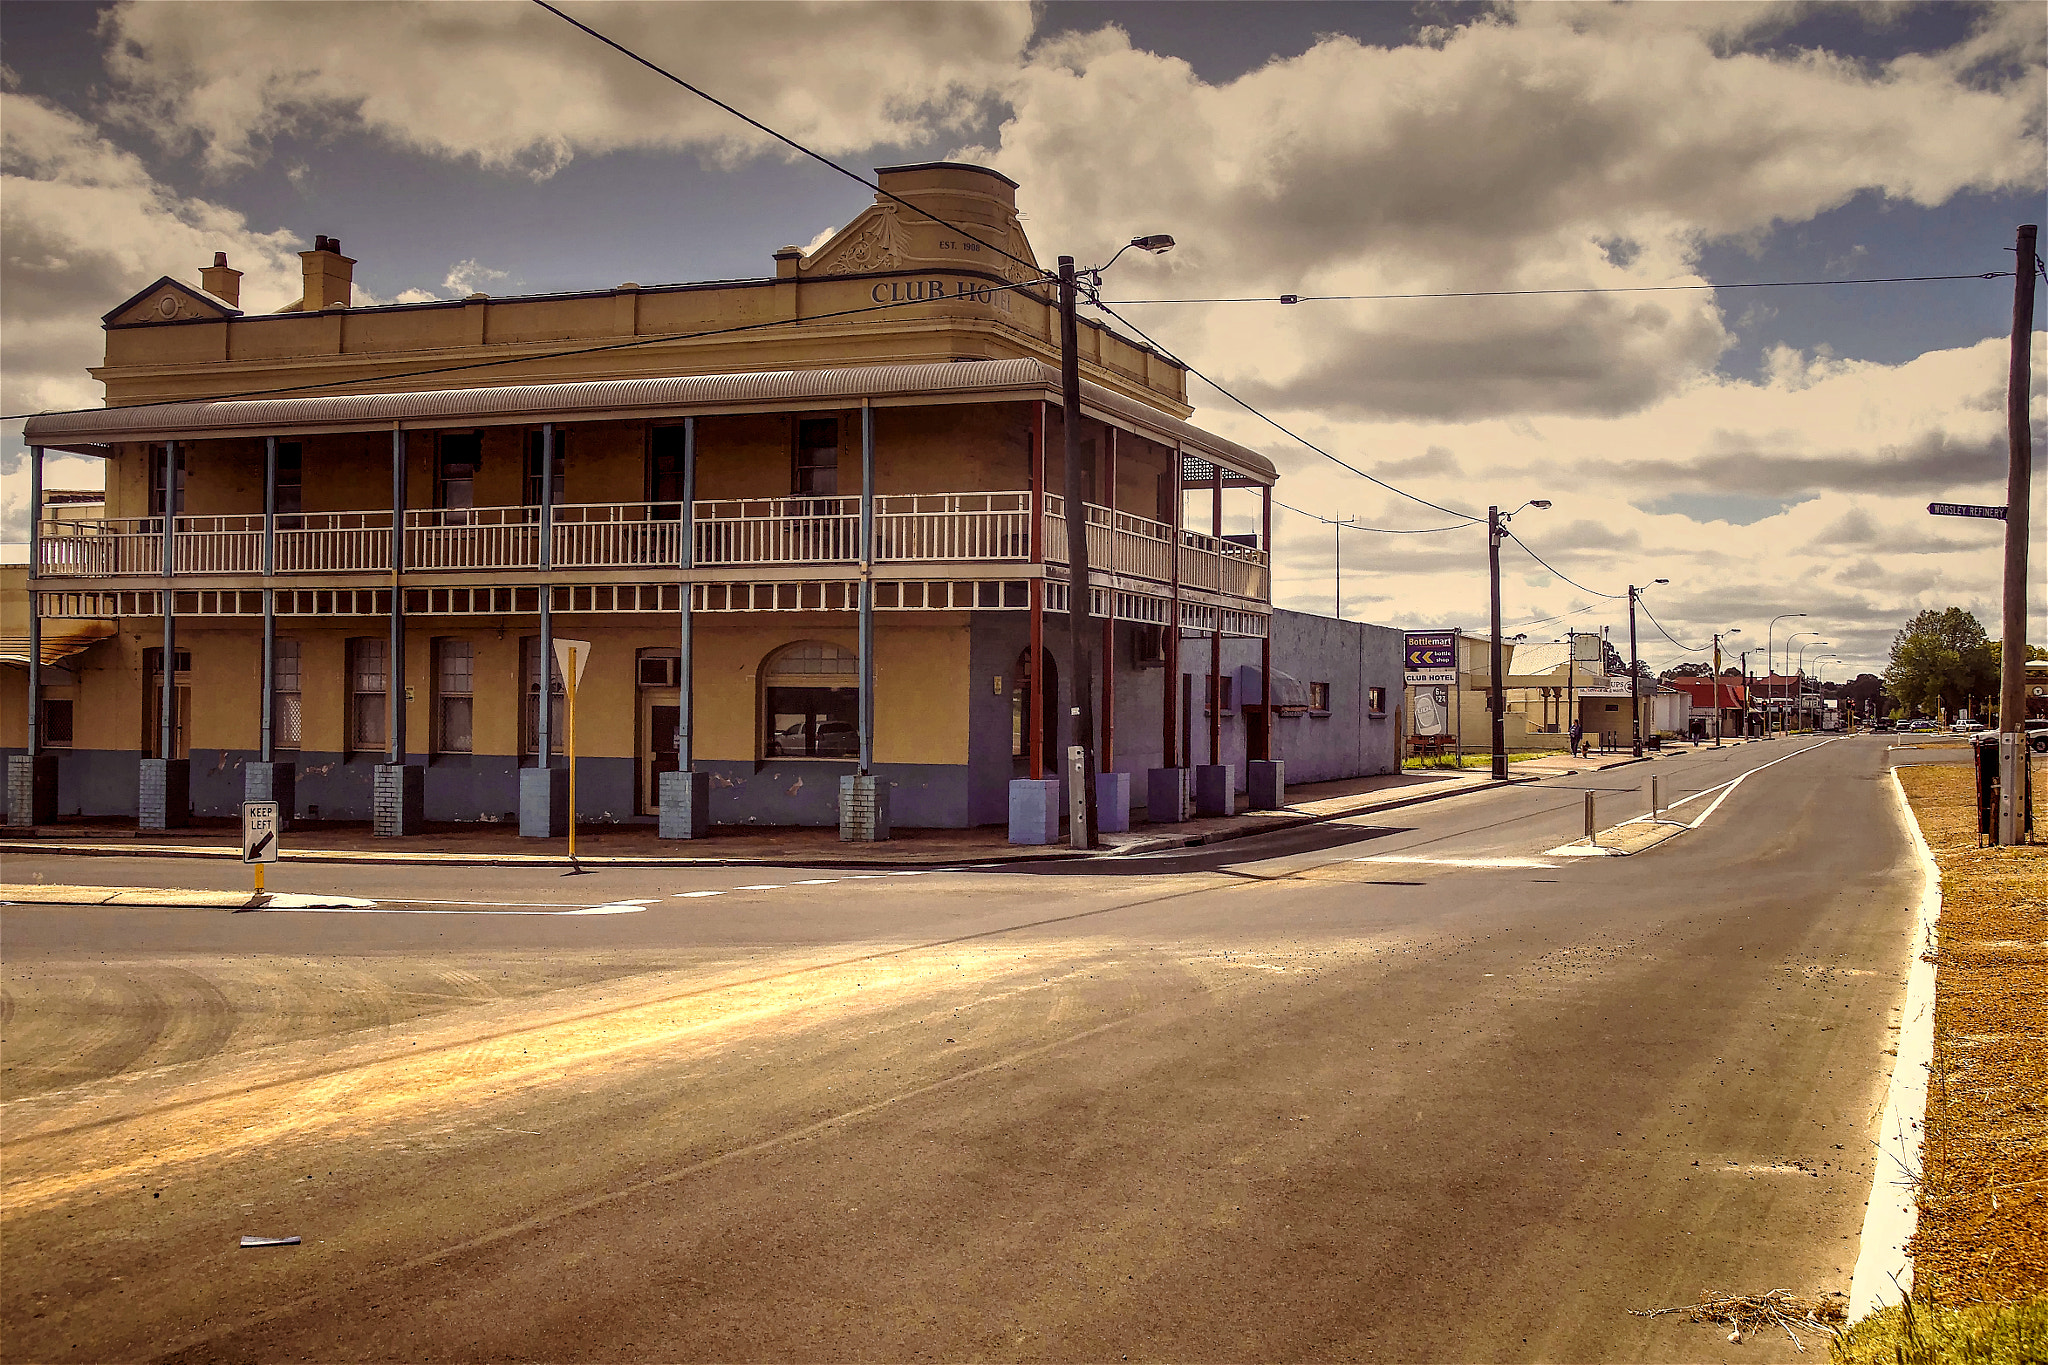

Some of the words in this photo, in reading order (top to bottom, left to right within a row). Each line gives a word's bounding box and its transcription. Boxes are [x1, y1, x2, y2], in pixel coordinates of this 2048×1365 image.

[939, 241, 957, 250] EST.
[871, 280, 944, 303] CLUB
[956, 281, 1012, 314] HOTEL
[1934, 505, 1967, 515] WORSLEY
[1969, 507, 2004, 517] REFINERY
[1408, 637, 1451, 646] Bottlemart
[250, 808, 272, 817] KEEP
[251, 820, 271, 829] LEFT
